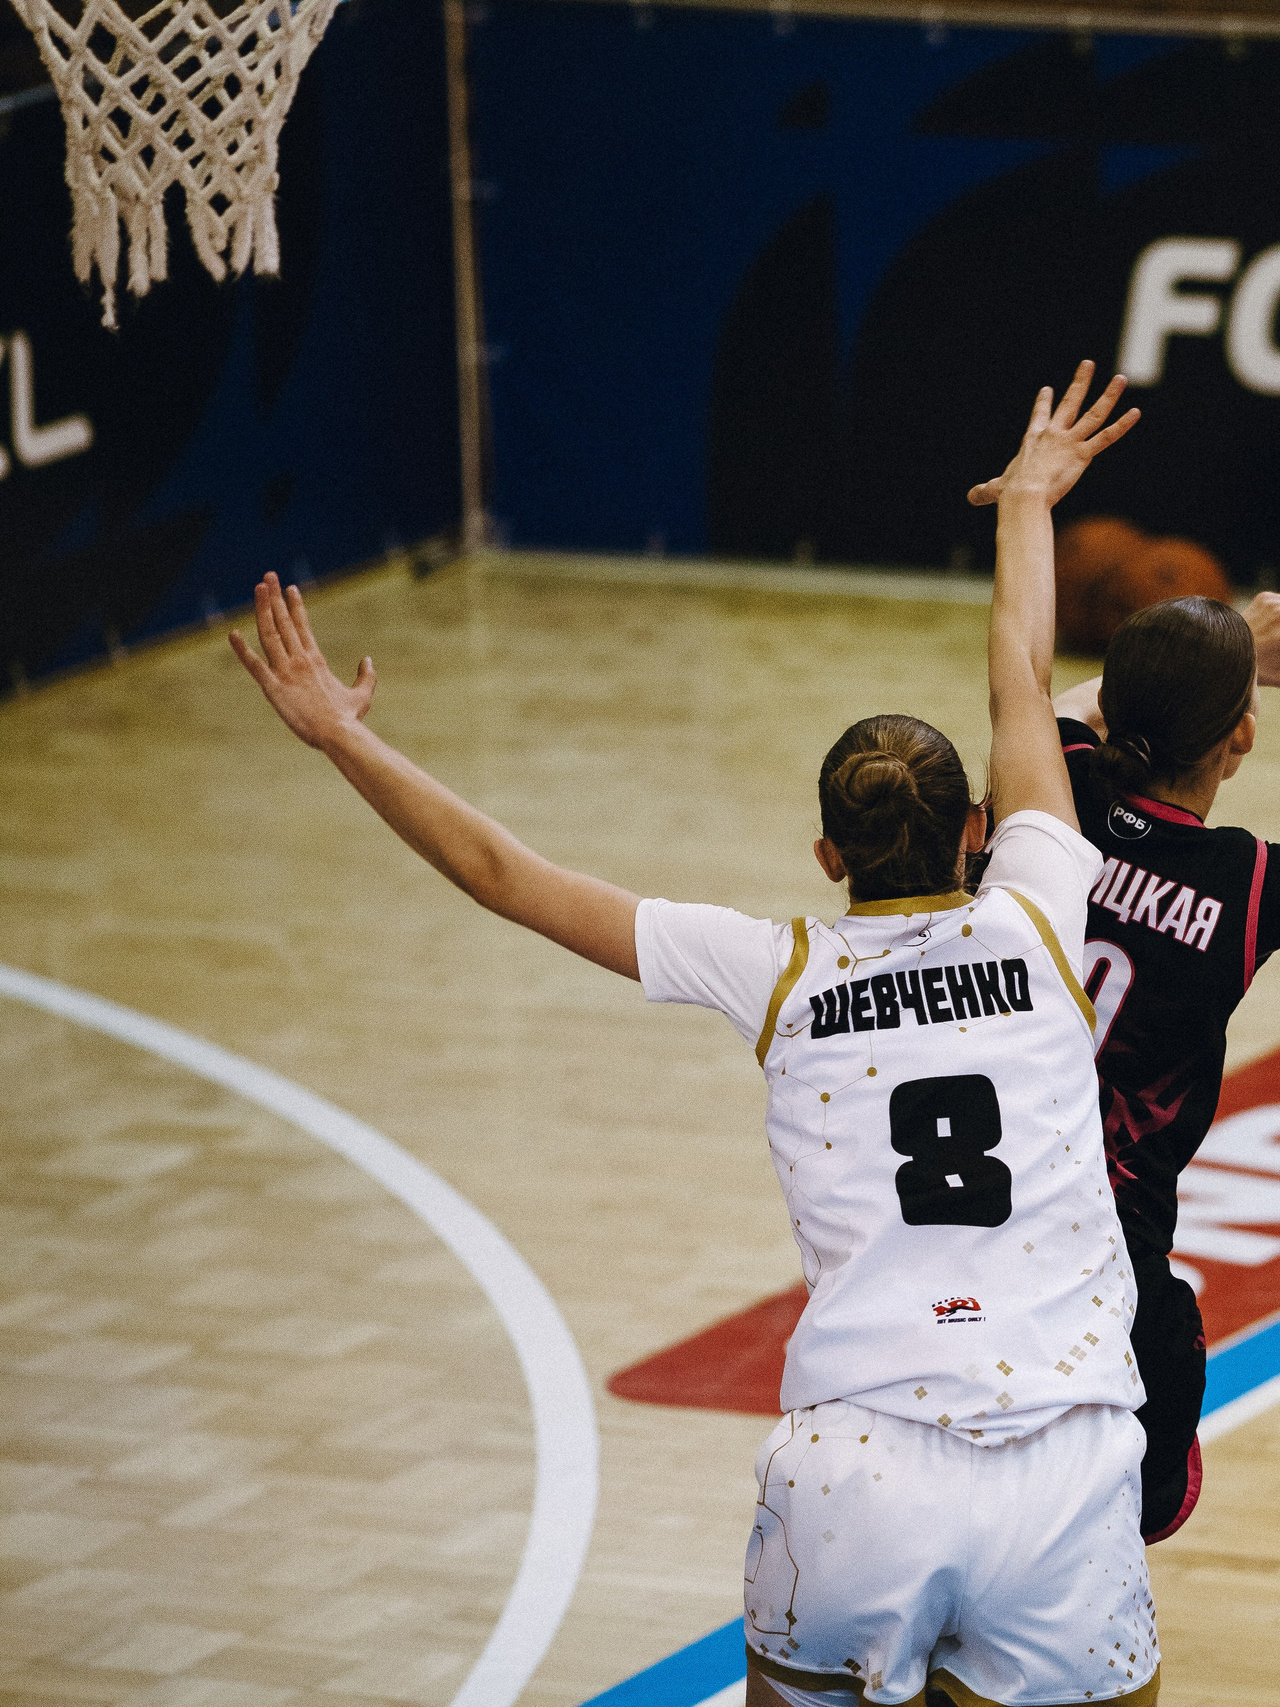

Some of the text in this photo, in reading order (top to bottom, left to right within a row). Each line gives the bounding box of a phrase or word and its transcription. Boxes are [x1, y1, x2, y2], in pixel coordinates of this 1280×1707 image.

[1113, 806, 1147, 830] РФБ
[1092, 856, 1223, 952] ИЦКАЯ
[809, 958, 1034, 1039] ШЕВЧЕНКО
[889, 1074, 1012, 1228] 8
